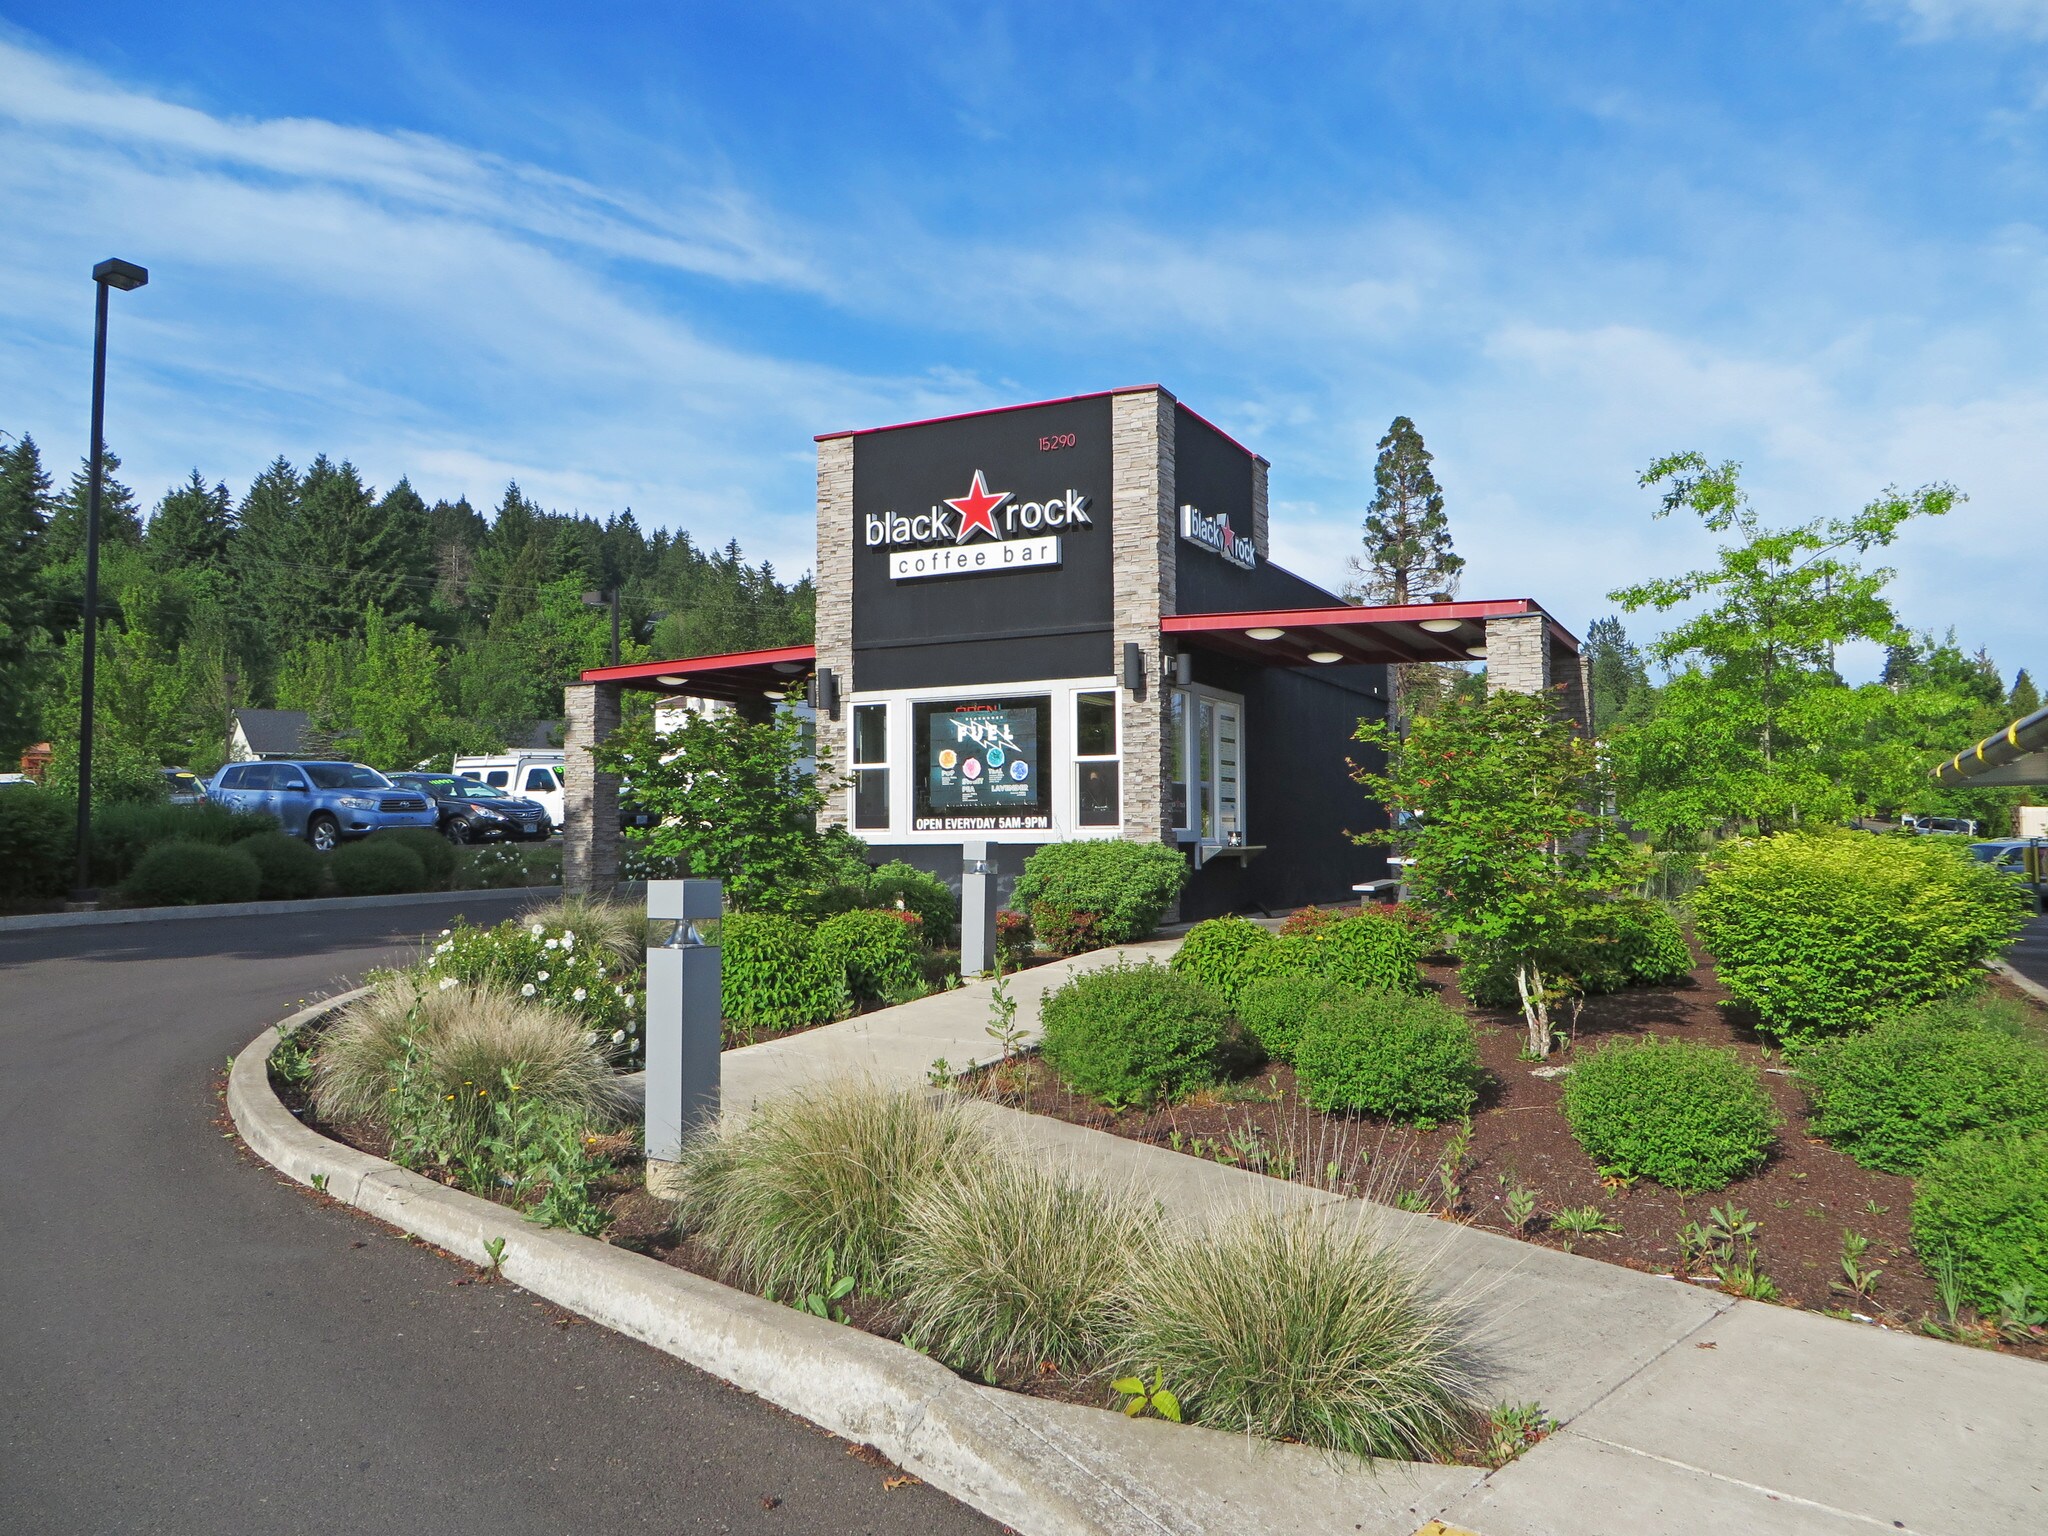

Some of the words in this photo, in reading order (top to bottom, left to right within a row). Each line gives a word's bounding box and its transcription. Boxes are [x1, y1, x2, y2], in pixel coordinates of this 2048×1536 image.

[1039, 433, 1076, 451] 15290
[866, 505, 954, 546] black
[1006, 489, 1091, 531] rock
[1191, 508, 1220, 547] black
[1235, 538, 1256, 566] rock
[899, 552, 986, 574] coffee
[1003, 545, 1048, 563] bar
[957, 723, 1014, 743] FUEL
[991, 783, 1029, 793] LAVENDER
[916, 818, 942, 830] OPEN
[945, 817, 997, 830] EVERYDAY
[998, 816, 1048, 829] 5AM-9PM
